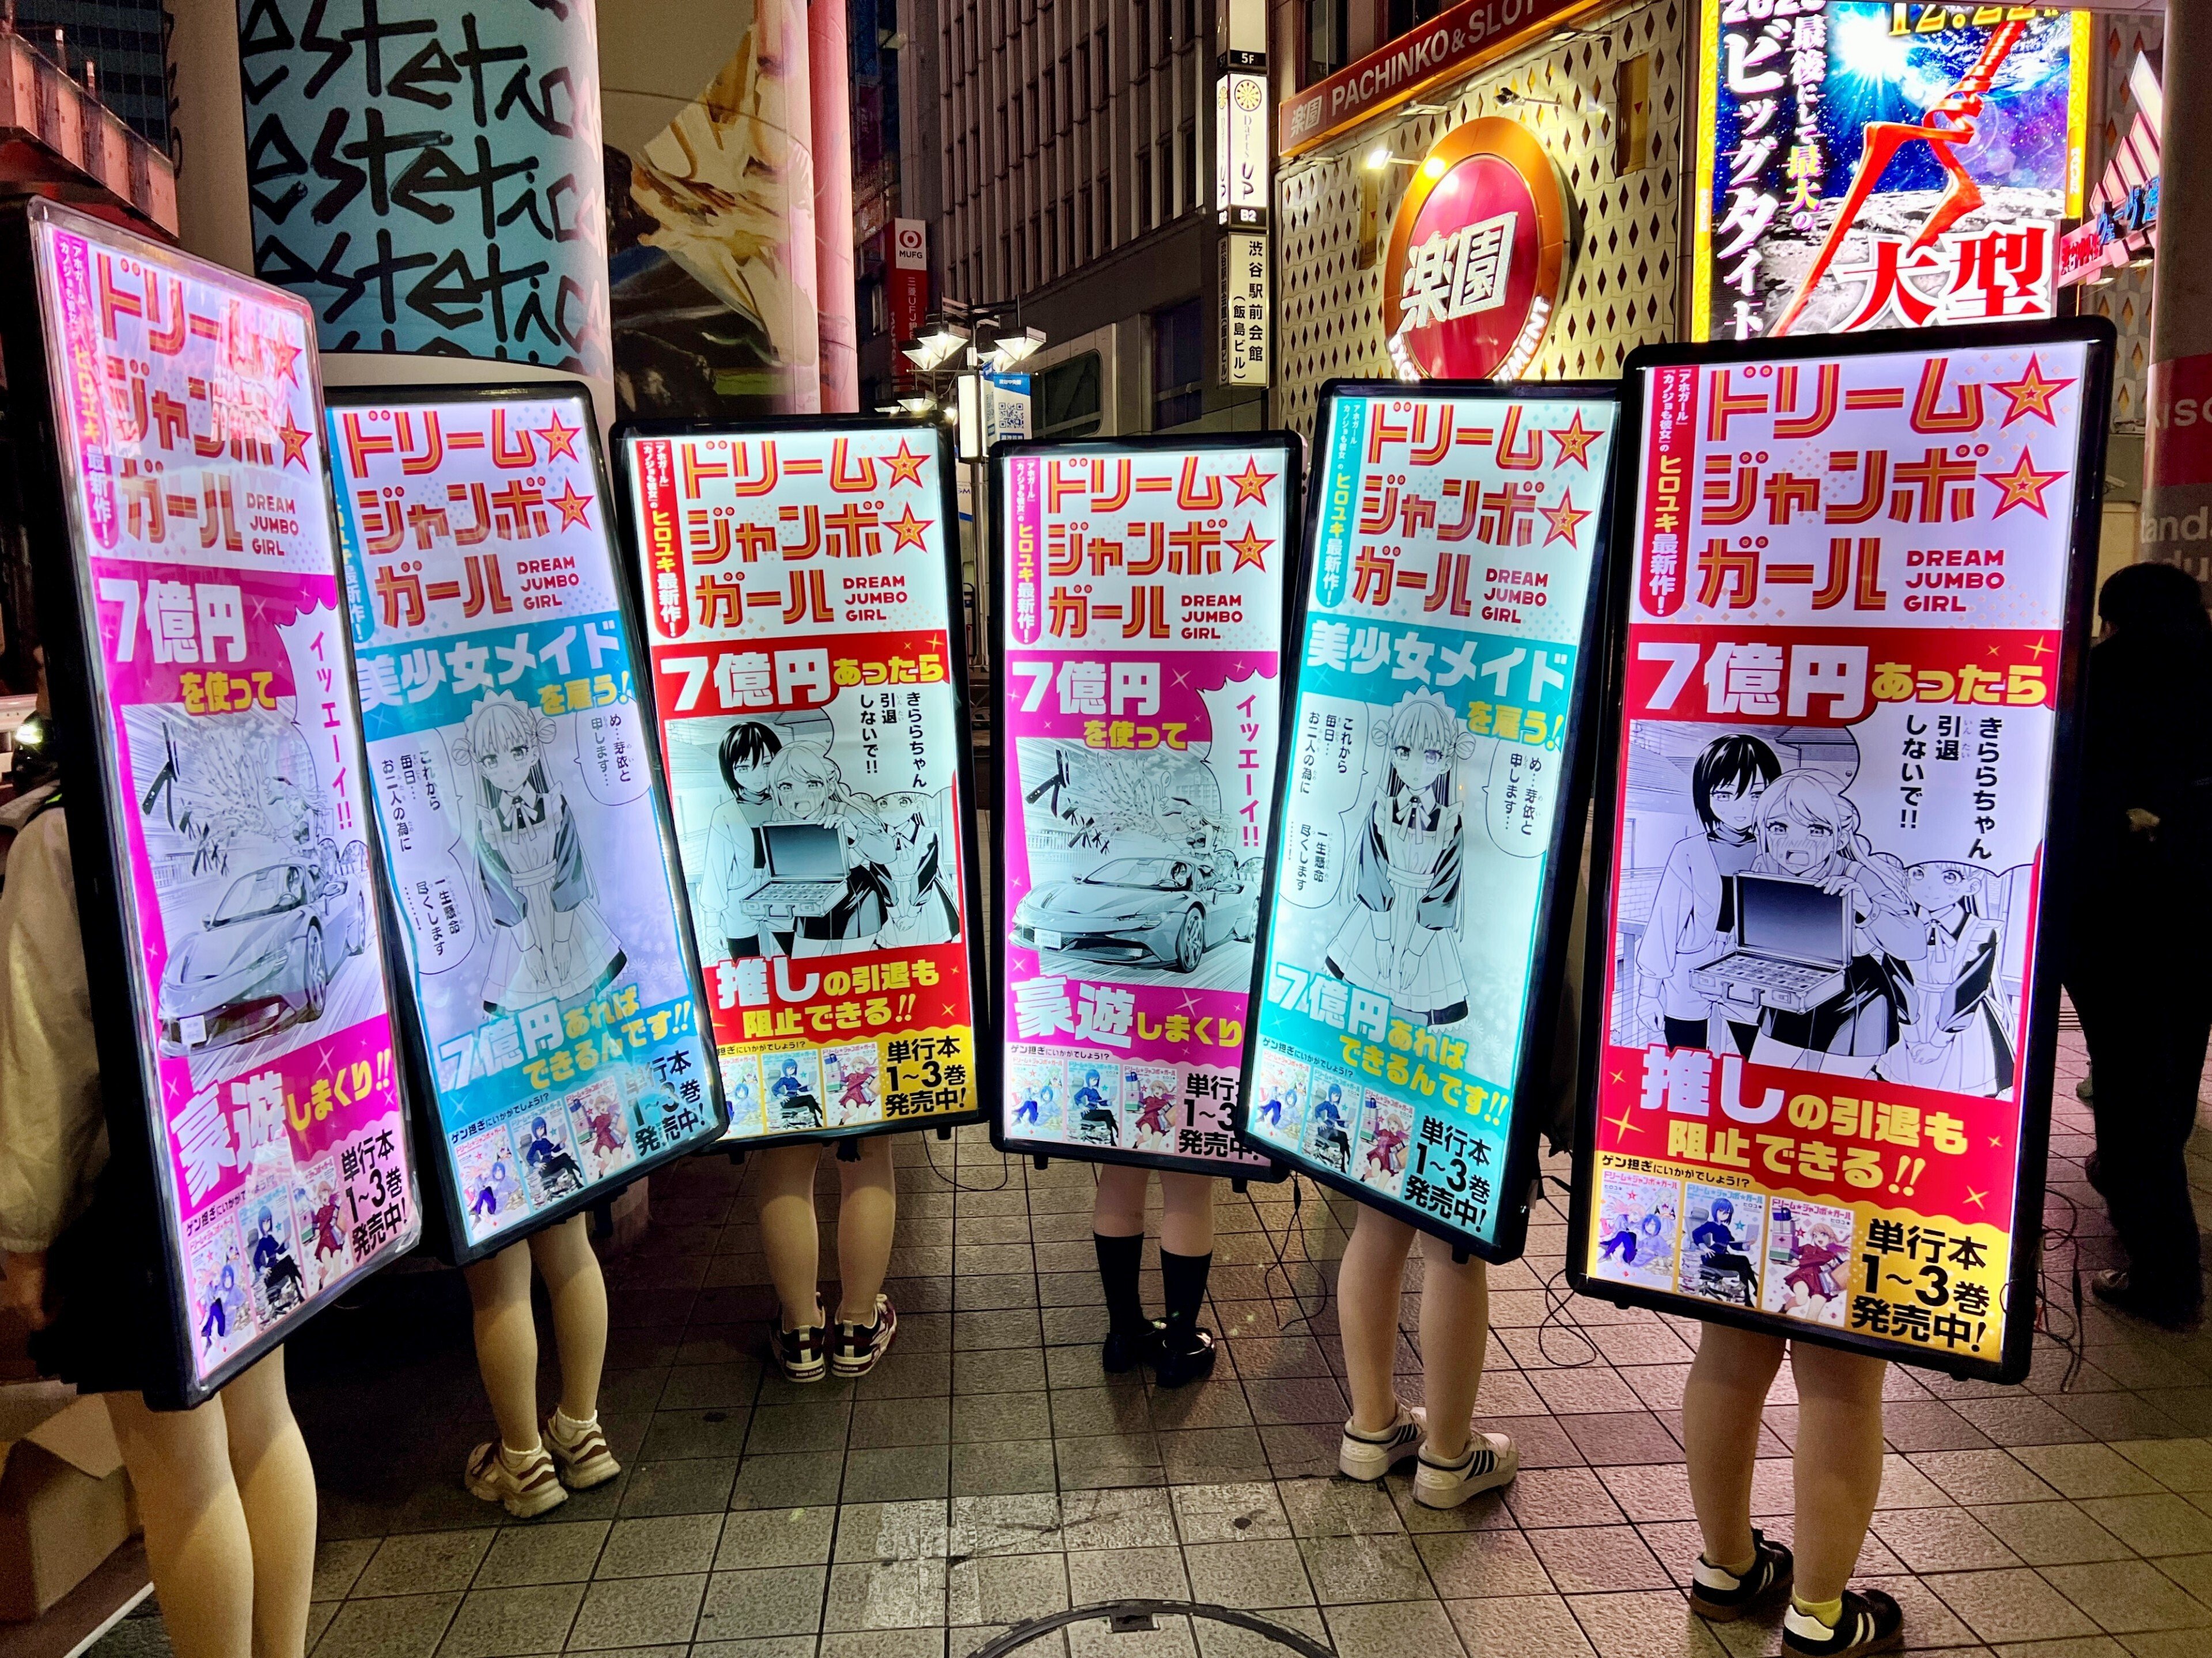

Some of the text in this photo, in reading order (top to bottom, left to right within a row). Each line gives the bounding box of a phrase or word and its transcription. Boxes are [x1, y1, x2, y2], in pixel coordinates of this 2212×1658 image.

[1241, 53, 1254, 64] 5F
[1290, 95, 1323, 139] 楽園
[1240, 209, 1256, 222] B2
[899, 251, 922, 259] MUFG
[1398, 211, 1518, 333] 楽園
[1839, 226, 2048, 331] 大型
[1249, 241, 1263, 361] 渋谷駅前会館
[121, 458, 243, 552] ガール
[247, 492, 296, 514] DREAM
[250, 515, 298, 536] JUMBO
[252, 538, 285, 556] GIRL
[517, 556, 575, 575] DREAM
[1906, 549, 2004, 567] DREAM
[374, 553, 513, 628] ガール
[521, 574, 579, 592] JUMBO
[695, 569, 834, 628] ガール
[843, 576, 905, 589] DREAM
[844, 592, 908, 604] JUMBO
[1352, 545, 1471, 617] ガール
[1484, 588, 1547, 607] JUMBO
[1485, 568, 1548, 587] DREAM
[1698, 536, 1886, 611] ガール
[1906, 572, 2005, 589] JUMBO
[99, 578, 247, 663] 7億円
[523, 594, 562, 610] GIRL
[846, 609, 887, 622] GIRL
[1048, 585, 1170, 639] ガール
[1181, 595, 1241, 606] DREAM
[1181, 611, 1243, 623] JUMBO
[1481, 606, 1521, 624] GIRL
[1904, 595, 1967, 612] GIRL
[1181, 628, 1221, 639] GIRL
[355, 620, 620, 713] 美少女メイド
[1306, 619, 1568, 703] 美少女メイド
[180, 671, 277, 716] を使って
[539, 671, 631, 716] を雇う!
[881, 693, 897, 724] 引退
[1012, 661, 1160, 716] 7億円
[860, 694, 878, 774] しないで!!
[906, 692, 927, 788] きららちゃん
[1083, 720, 1188, 750] を使って
[1337, 718, 1354, 774] これから
[1465, 700, 1564, 752] を雇う!
[1936, 715, 1960, 760] 引退
[1300, 711, 1319, 794] お二人の為に
[1900, 715, 1927, 829] しないで!!
[420, 750, 440, 810] これから
[1968, 716, 2003, 860] きららちゃん
[382, 760, 412, 852] お二人の為に
[717, 957, 940, 1009] 推しの引退も
[743, 994, 916, 1038] 阻止できる!!
[522, 1001, 690, 1090] できるんです!!
[888, 1035, 960, 1064] 単行本
[624, 1050, 692, 1094] 単行本
[1186, 1073, 1240, 1101] 単行
[1339, 1035, 1509, 1125] できるんです!!
[885, 1087, 966, 1118] 発売中!
[1640, 1046, 1969, 1156] 推しの引退も
[341, 1129, 394, 1181] 単行本
[635, 1103, 706, 1156] 発売中!
[1419, 1115, 1491, 1167] 単行本
[1601, 1155, 1750, 1187] ゲン担ぎにいかがでしょう!?
[1667, 1121, 1927, 1197] 阻止できる!!
[1404, 1174, 1487, 1232] 発売中!
[351, 1197, 408, 1263] 発売中!
[1866, 1219, 1987, 1270] 単行本
[1851, 1296, 1986, 1352] 発売中!
